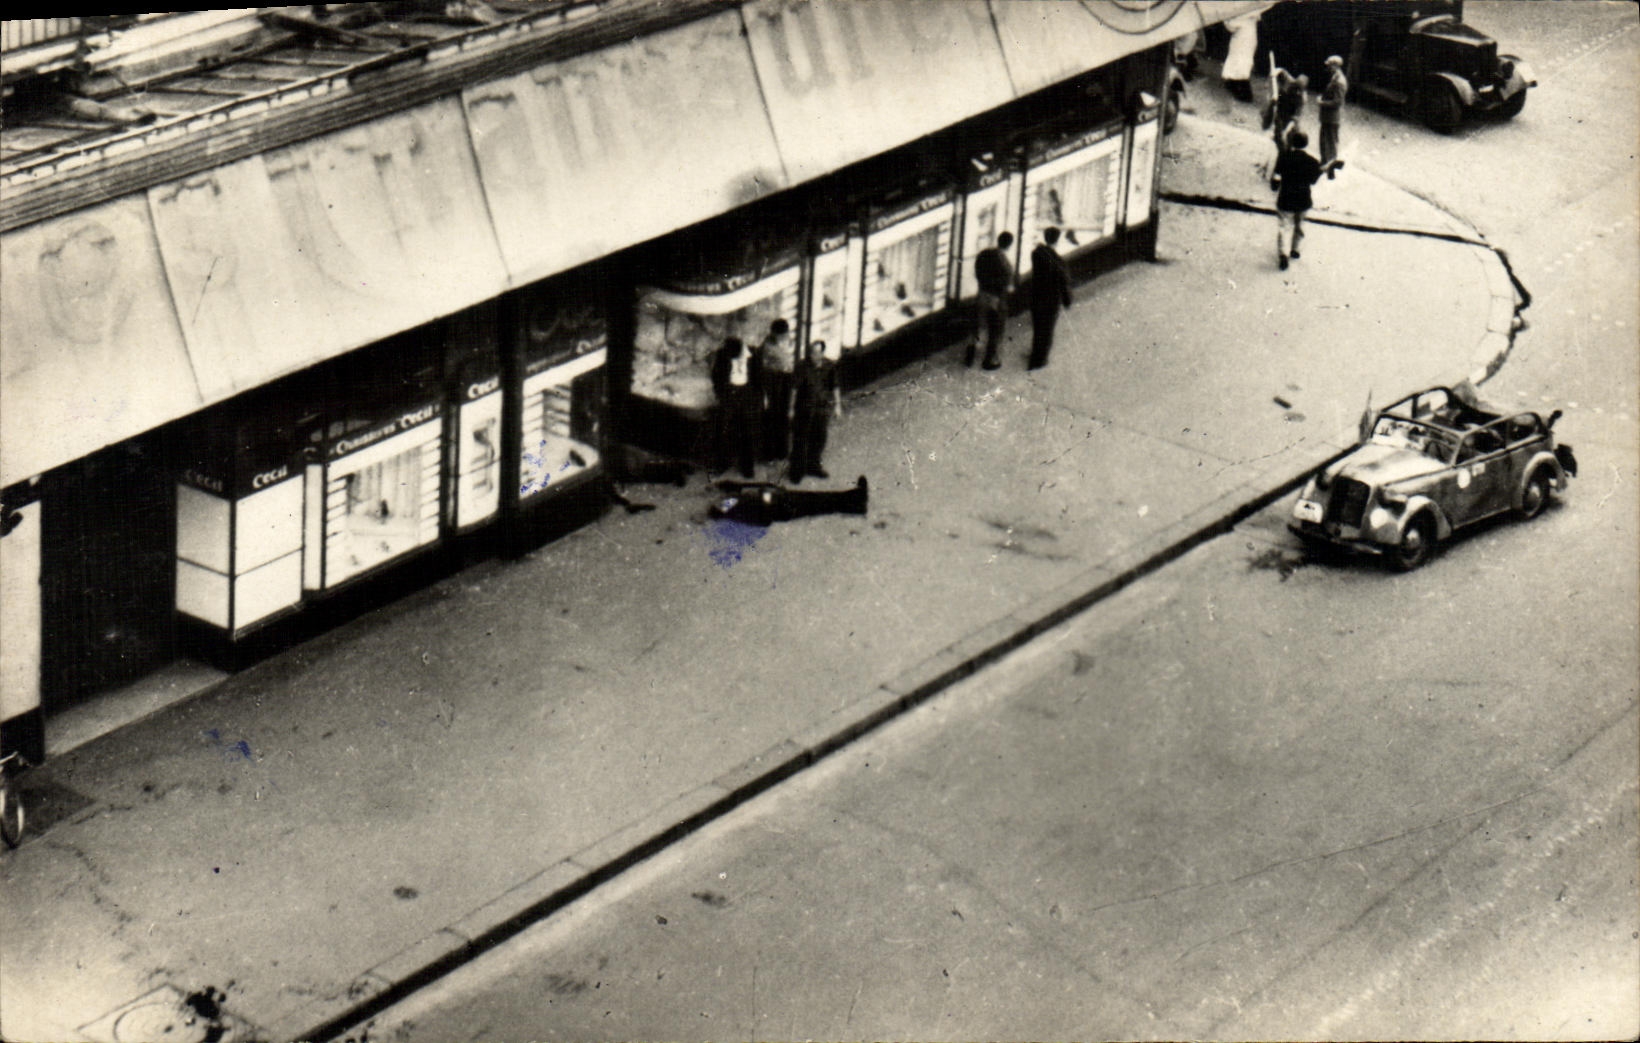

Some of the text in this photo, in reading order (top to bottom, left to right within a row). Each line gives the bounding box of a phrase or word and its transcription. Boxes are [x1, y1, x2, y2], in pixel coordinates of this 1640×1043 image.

[467, 375, 499, 399] Cecil
[399, 403, 434, 430] Cecil
[252, 464, 288, 489] Cecil
